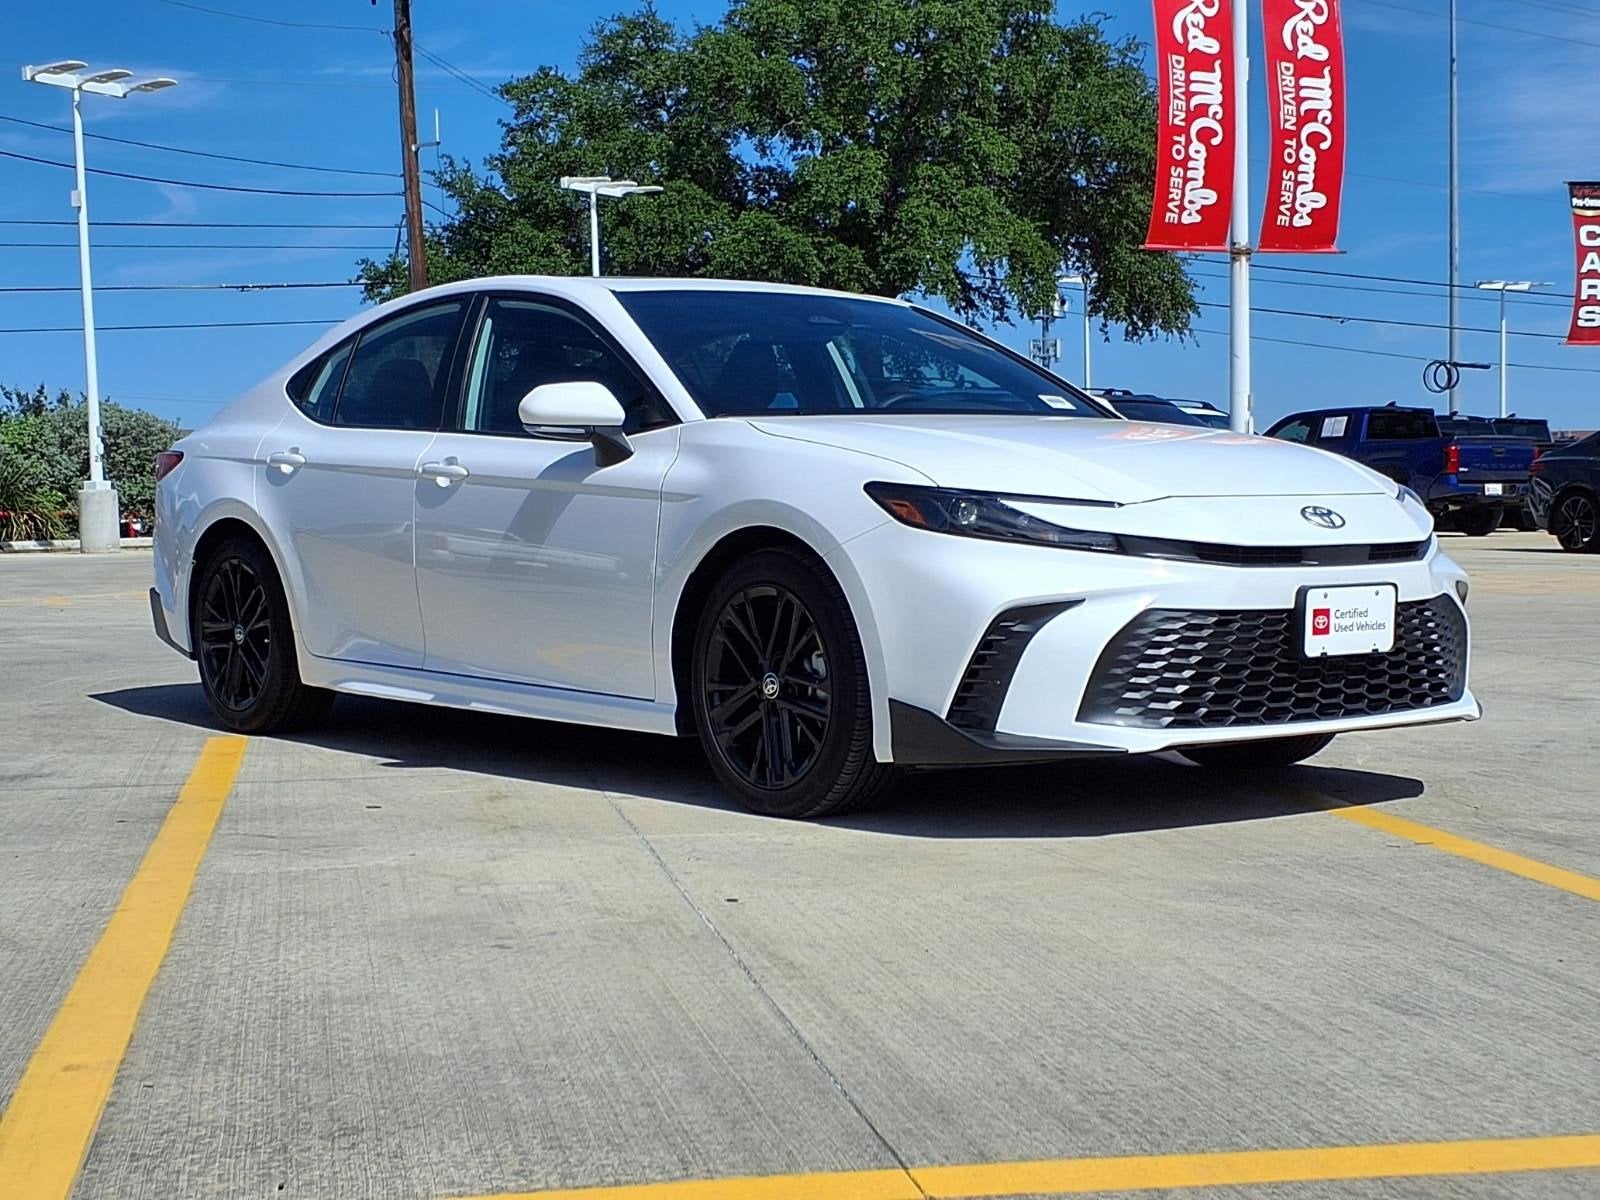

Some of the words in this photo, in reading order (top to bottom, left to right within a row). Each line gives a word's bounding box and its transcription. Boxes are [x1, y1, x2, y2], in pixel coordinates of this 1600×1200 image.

[1173, 0, 1220, 54] Red
[1282, 0, 1329, 61] Red
[1171, 54, 1186, 126] DRIVEN
[1280, 61, 1297, 130] DRIVEN
[1172, 133, 1185, 160] TO
[1181, 59, 1223, 224] McCombs
[1283, 138, 1296, 164] TO
[1292, 66, 1332, 228] McCombs
[1165, 166, 1184, 224] SERVE
[1276, 171, 1295, 227] SERVE
[1334, 608, 1368, 619] Certified
[1334, 622, 1354, 632] Used
[1356, 620, 1386, 632] Vehicles
